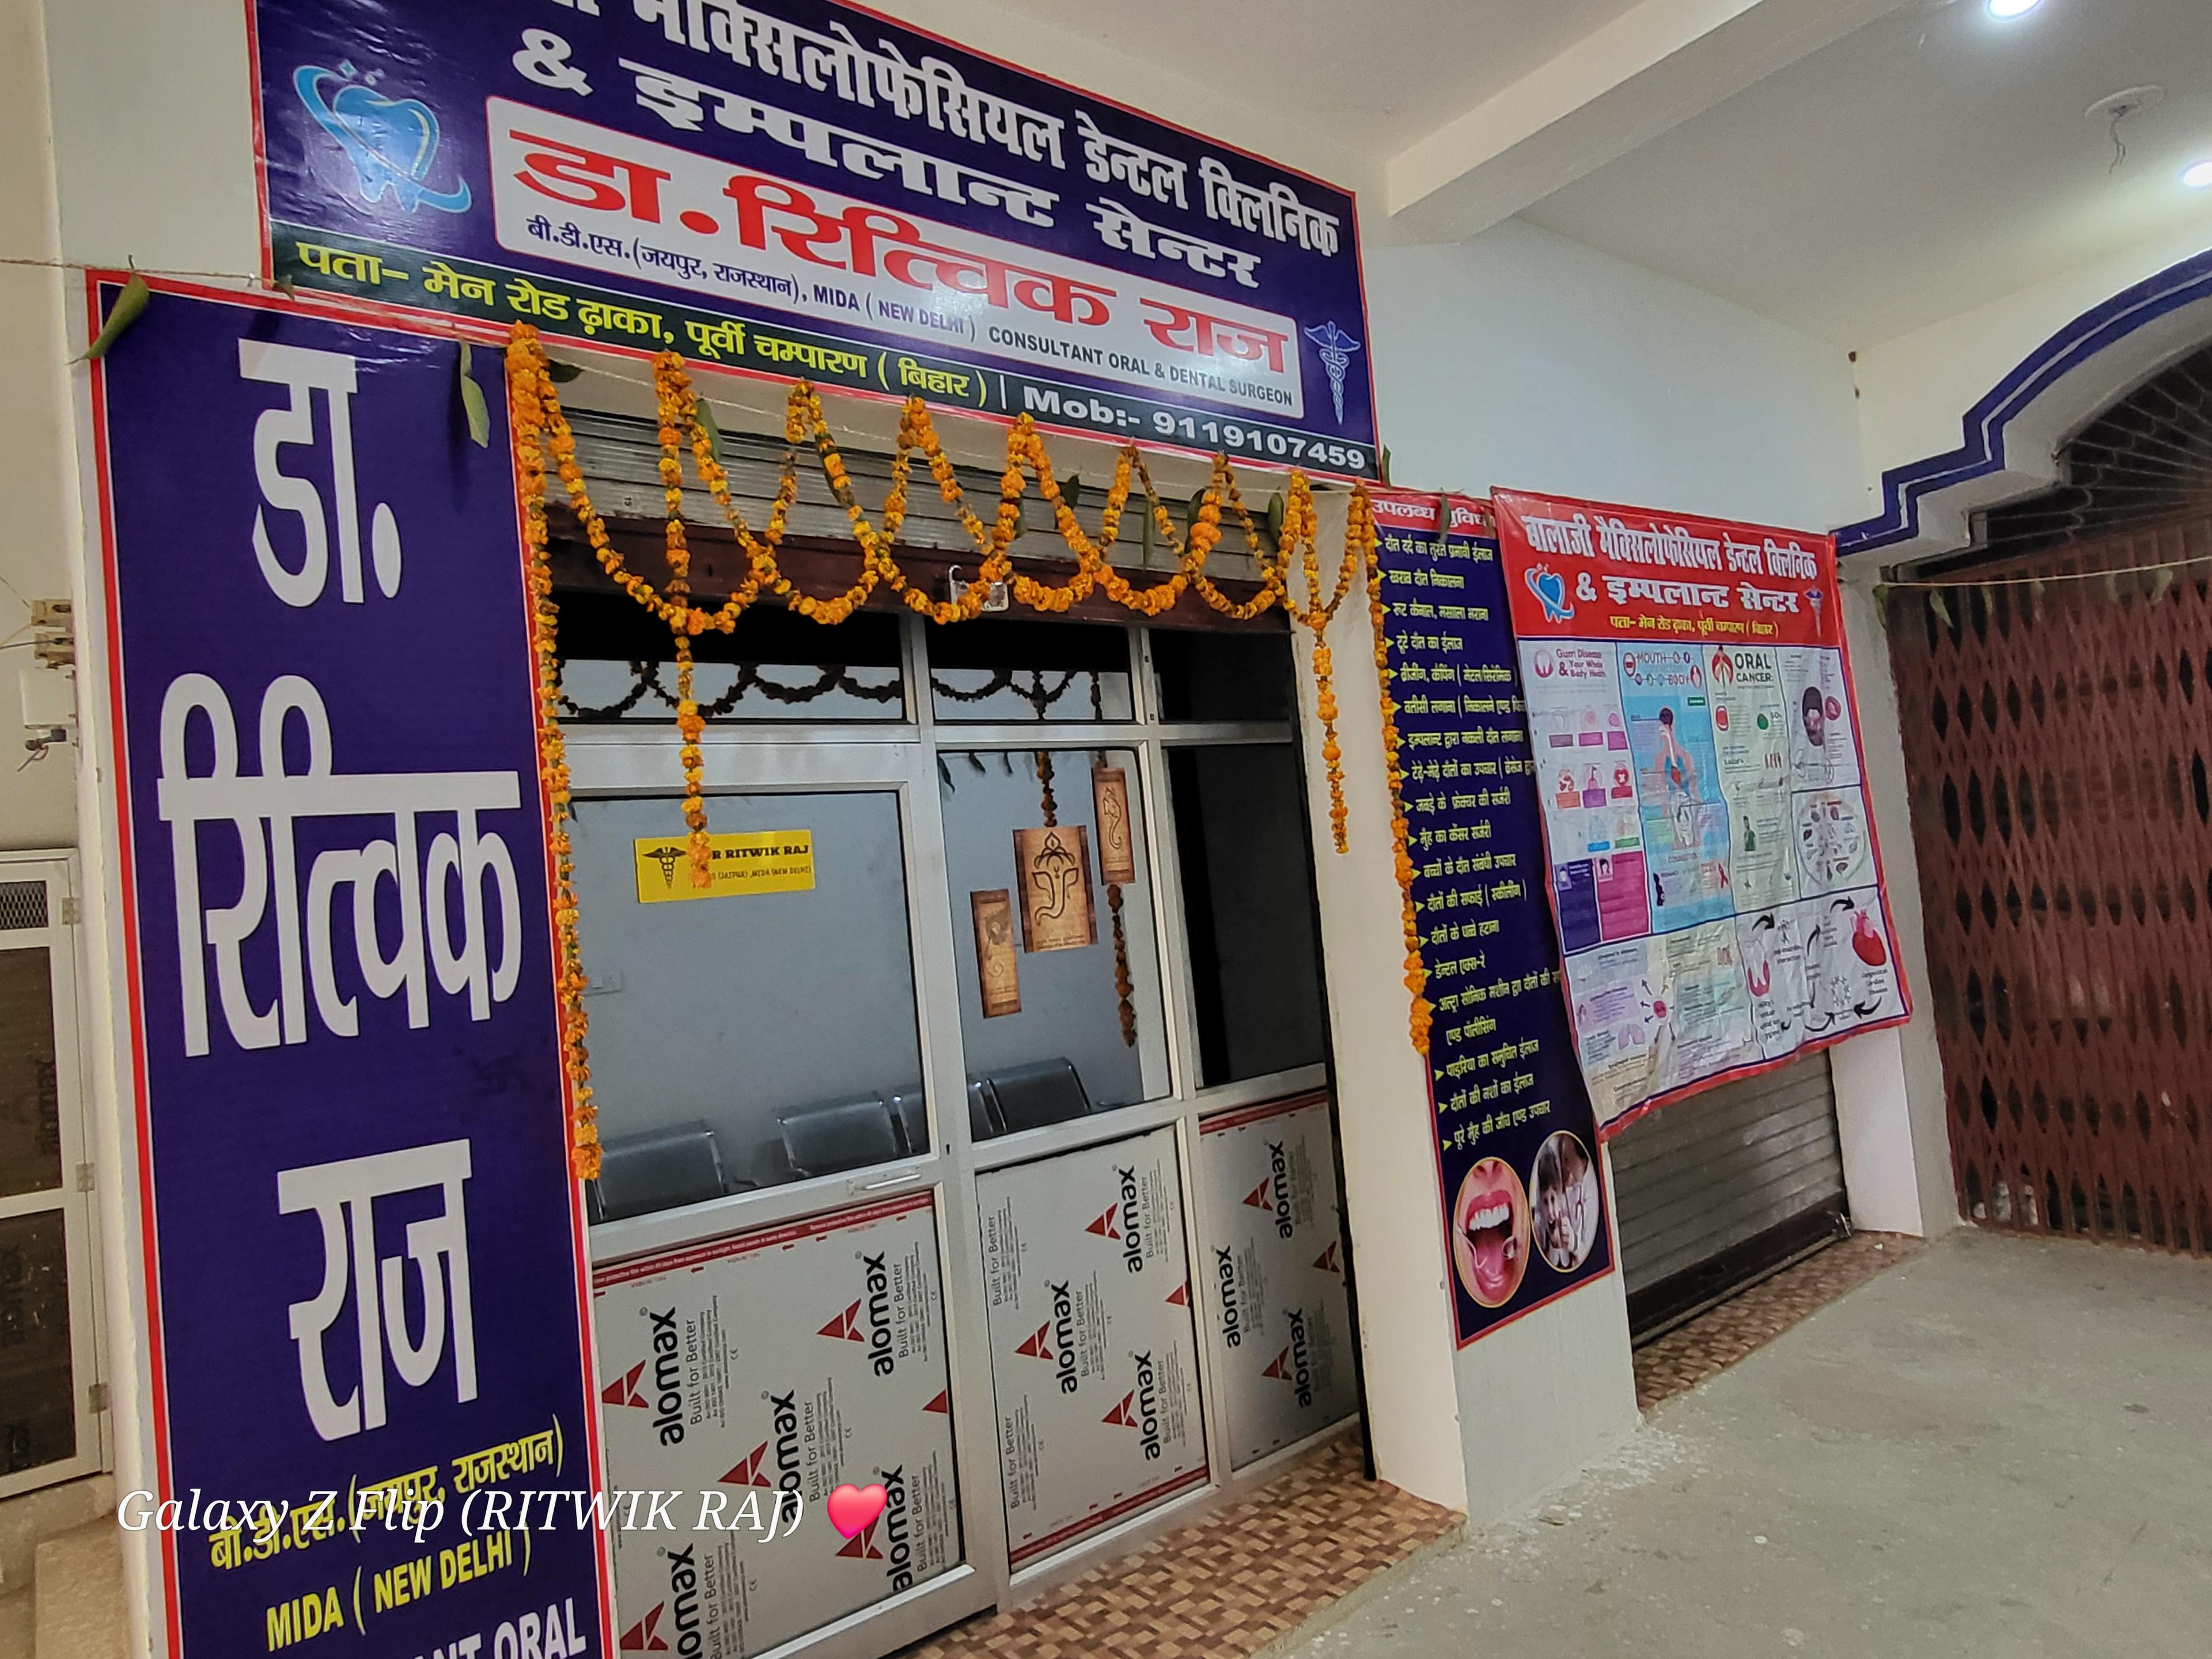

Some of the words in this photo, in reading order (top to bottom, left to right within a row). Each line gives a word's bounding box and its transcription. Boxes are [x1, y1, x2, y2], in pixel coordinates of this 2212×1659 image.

[634, 0, 1065, 170] मक्सिलोफेसियल
[1075, 109, 1186, 211] डेन्टल
[1199, 157, 1339, 256] क्लिनिक
[513, 28, 593, 96] &
[619, 57, 1060, 228] इम्पलान्ट
[1086, 196, 1260, 288] सेन्टर
[813, 286, 860, 312] MIDA
[878, 301, 914, 325] NEW
[918, 308, 964, 335] DELHI
[988, 327, 1103, 366] CONSULTANT
[1108, 353, 1150, 377] ORAL
[1154, 363, 1164, 380] &
[1169, 366, 1225, 394] DENTAL
[1229, 378, 1293, 407] SURGEON
[1140, 297, 1287, 372] राज
[297, 241, 407, 286] पता-
[423, 262, 494, 307] मेन
[506, 279, 569, 320] रोड
[687, 319, 745, 360] पूर्वी
[753, 333, 868, 380] चम्पारण
[898, 360, 971, 398] बिहार
[1024, 386, 1141, 430] Mob:-
[1153, 411, 1365, 470] 9119107459
[238, 339, 402, 607] डा.
[1370, 499, 1435, 520] उपलब्ध
[1415, 541, 1427, 555] का
[1521, 513, 1595, 558] बालाजी
[1723, 532, 1763, 575] डेन्टल
[1764, 539, 1817, 580] क्लिनिक
[1576, 572, 1597, 602] &
[1602, 575, 1729, 608] इम्पलान्ट
[1737, 582, 1800, 613] सेन्टर
[1638, 614, 1654, 629] मेन
[1657, 615, 1671, 630] रोड
[1427, 637, 1439, 650] का
[1735, 653, 1771, 669] ORAL
[1559, 661, 1569, 676] &
[1460, 764, 1472, 776] का
[1437, 791, 1446, 810] के
[1478, 788, 1489, 806] की
[726, 847, 779, 859] RITWIK
[784, 844, 809, 855] RAJ
[1434, 830, 1446, 843] का
[157, 673, 522, 1058] रित्विक
[1444, 856, 1454, 874] के
[1446, 888, 1459, 907] की
[1450, 922, 1459, 940] के
[1540, 967, 1550, 986] की
[1478, 1054, 1489, 1068] का
[1469, 1084, 1480, 1104] की
[1500, 1080, 1512, 1094] का
[1482, 1114, 1493, 1134] की
[1268, 1141, 1293, 1239] alomax
[988, 1217, 998, 1253] Better
[1118, 1165, 1143, 1274] alomax
[894, 1264, 904, 1302] Better
[990, 1258, 999, 1274] for
[277, 1139, 478, 1442] राज
[992, 1278, 1002, 1306] Built
[1215, 1244, 1241, 1349] alomax
[863, 1251, 894, 1377] alomax
[896, 1307, 906, 1324] for
[685, 1320, 698, 1362] Better
[898, 1328, 908, 1358] Built
[1051, 1280, 1078, 1394] alomax
[1287, 1308, 1312, 1408] alomax
[649, 1307, 685, 1446] alomax
[687, 1368, 699, 1387] for
[688, 1391, 702, 1425] Built
[804, 1402, 815, 1442] Better
[1135, 1350, 1160, 1461] alomax
[806, 1446, 817, 1465] for
[808, 1469, 820, 1502] Built
[881, 1464, 913, 1591] alomax
[266, 1592, 344, 1652] MIDA
[373, 1556, 431, 1613] NEW
[440, 1529, 512, 1589] DELHI
[704, 1555, 717, 1600] Better
[667, 1543, 702, 1659] omax
[706, 1604, 718, 1624] for
[494, 1597, 586, 1659] ORAL
[709, 1626, 722, 1659] Built
